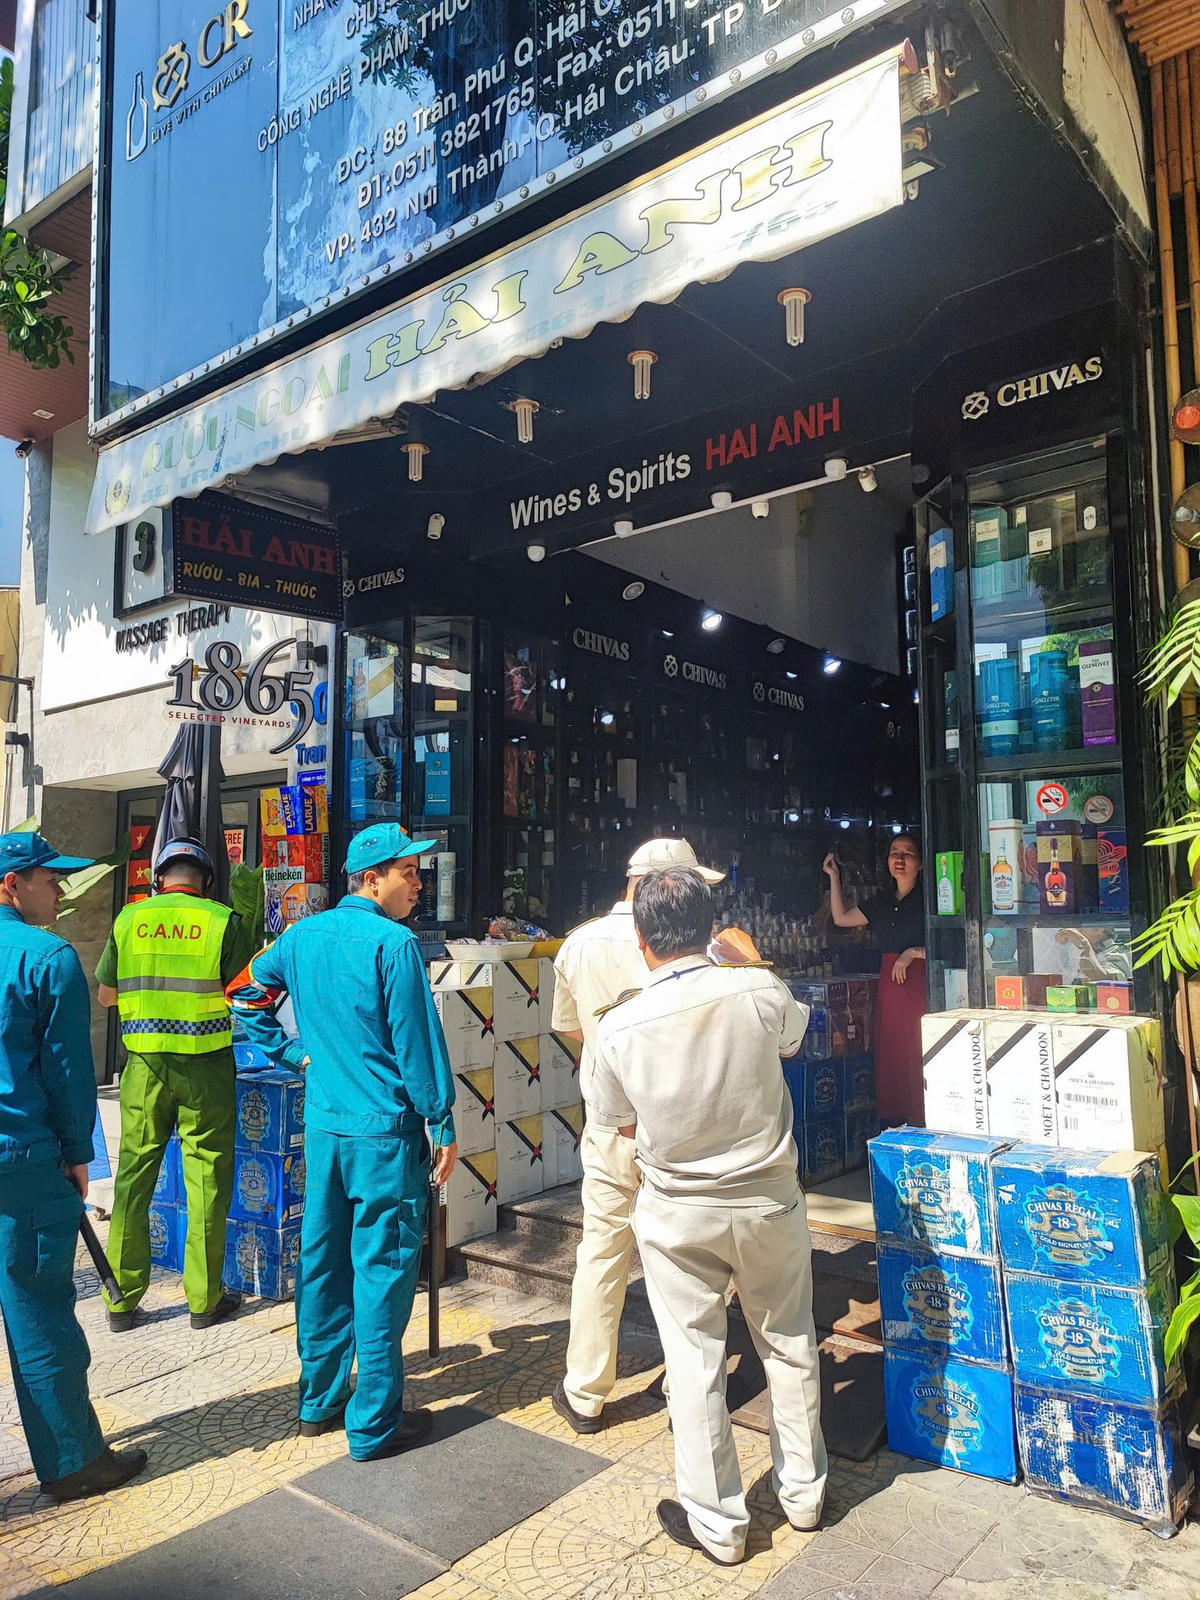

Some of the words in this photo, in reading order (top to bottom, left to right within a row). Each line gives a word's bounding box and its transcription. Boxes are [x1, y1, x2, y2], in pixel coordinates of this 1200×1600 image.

[151, 122, 173, 145] LIVE
[176, 98, 201, 125] WITH
[203, 56, 252, 103] CHIVALRY
[257, 106, 301, 152] CÔNG
[305, 65, 351, 120] NGHỆ
[440, 76, 535, 158] 3821765
[325, 232, 355, 264] VP:
[361, 207, 397, 244] 432
[405, 183, 438, 220] Núi
[447, 138, 519, 196] Thành
[614, 38, 696, 97] Châu.
[702, 2, 745, 46] TP
[336, 145, 375, 185] ĐC:
[382, 119, 408, 154] 88
[412, 89, 457, 135] Trần
[464, 55, 505, 102] Phú
[364, 269, 529, 382] HẢI
[553, 119, 834, 295] ANH
[997, 356, 1103, 407] CHIVAS
[510, 487, 582, 530] Wines
[587, 482, 601, 505] &
[607, 451, 691, 503] Spirits
[705, 423, 758, 471] HAI
[767, 397, 842, 452] ANH
[133, 521, 155, 573] 3
[182, 513, 254, 559] HẢI
[262, 535, 337, 575] ANH
[237, 571, 261, 590] BIA
[358, 567, 405, 592] CHIVAS
[116, 617, 169, 654] MASSAGE
[176, 603, 231, 637] THERAPY
[572, 627, 631, 662] CHIVAS
[682, 660, 727, 690] CHIVAS
[166, 637, 315, 754] 1865
[767, 687, 806, 712] CHIVAS
[168, 711, 226, 723] SELECTED
[231, 717, 291, 729] VINEYARDS
[282, 794, 293, 829] LARUE
[304, 798, 314, 832] LARUE
[224, 833, 242, 845] FREE
[265, 868, 303, 881] Heineken
[136, 922, 202, 940] C.A.N.D
[1038, 1031, 1051, 1091] CHANDON
[1027, 1201, 1063, 1213] CHIVAS
[1064, 1203, 1098, 1220] REGAL
[1057, 1216, 1071, 1230] 18
[905, 1281, 936, 1291] CHIVAS
[937, 1283, 967, 1302] REGAL
[930, 1296, 942, 1308] 18
[1040, 1314, 1076, 1327] CHIVAS
[1078, 1316, 1111, 1336] REGAL
[1071, 1331, 1084, 1344] 18
[914, 1387, 946, 1398] CHIVAS
[947, 1390, 977, 1413] REGAL
